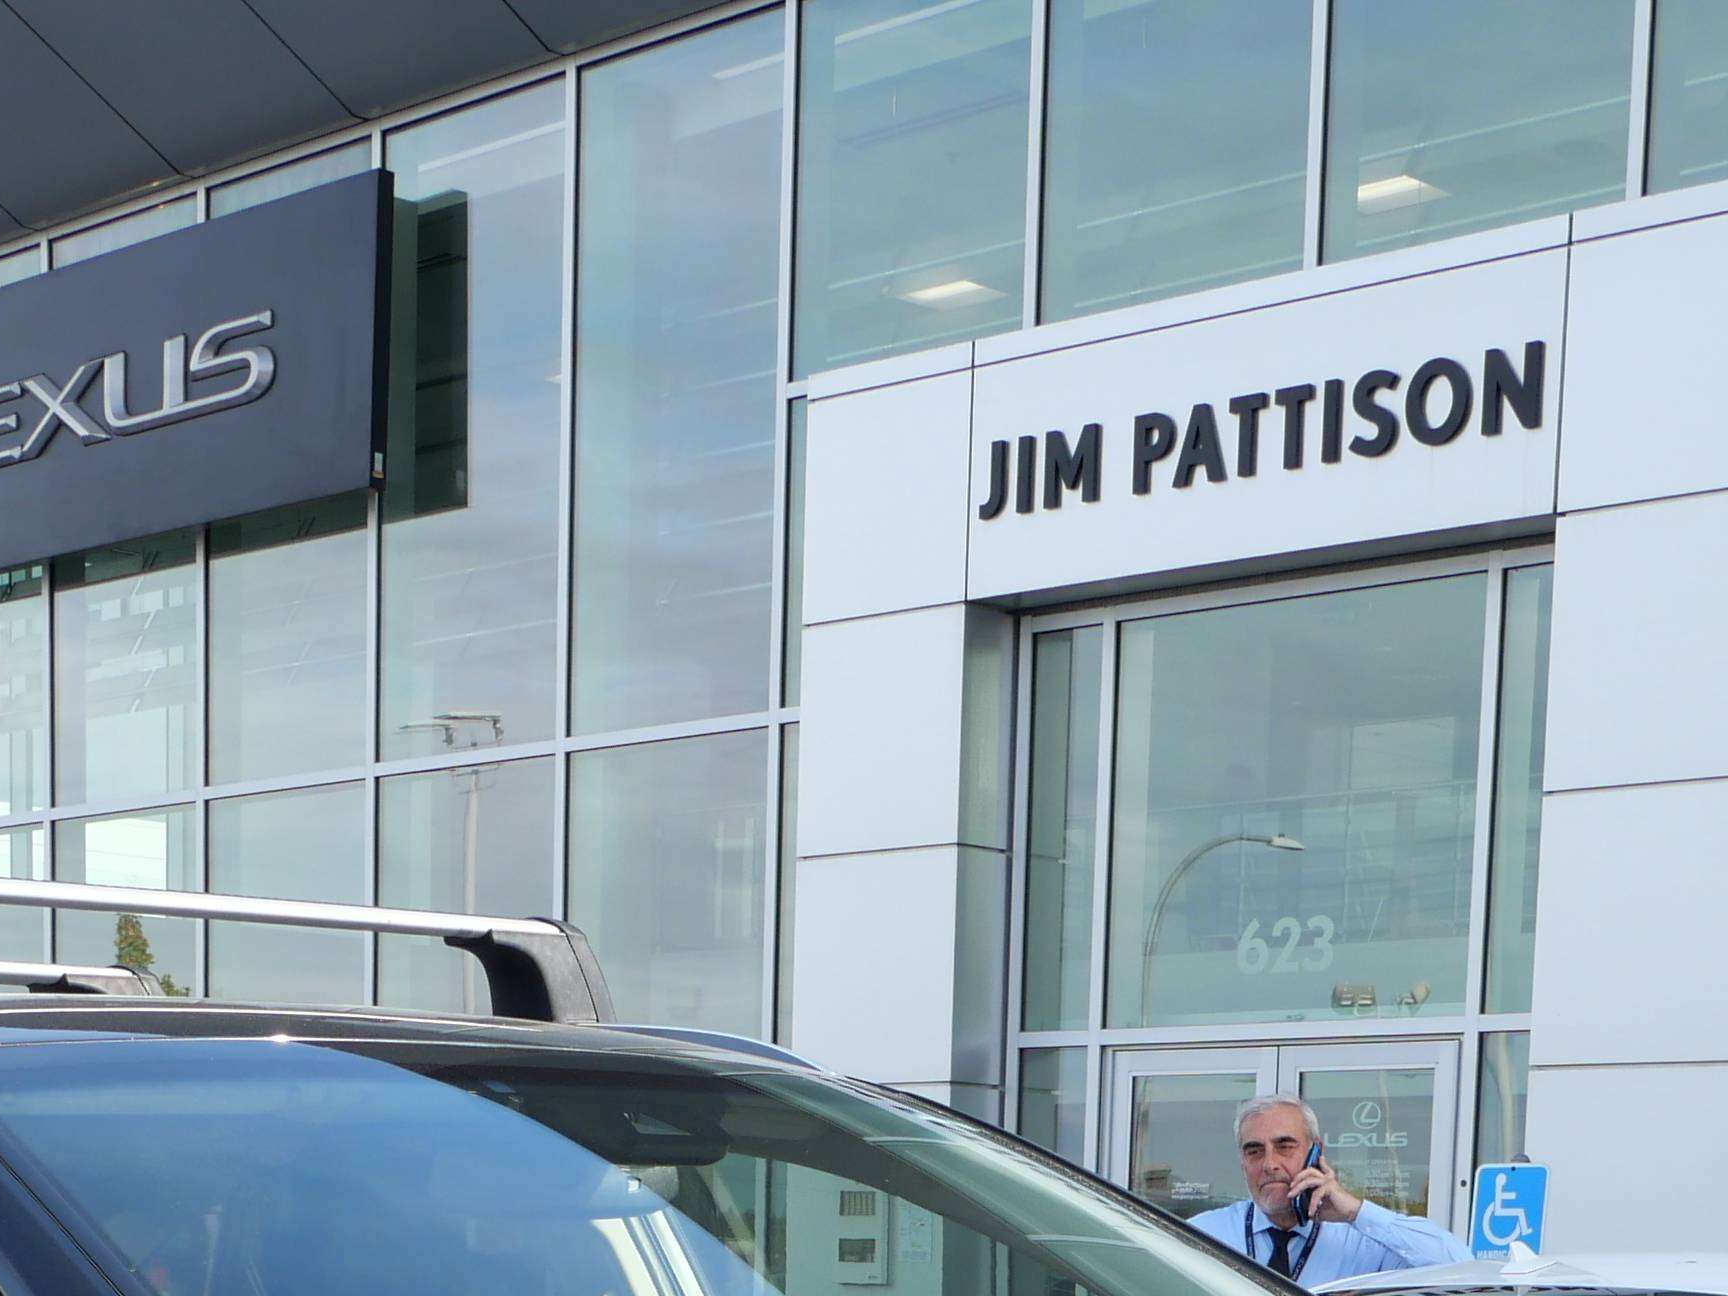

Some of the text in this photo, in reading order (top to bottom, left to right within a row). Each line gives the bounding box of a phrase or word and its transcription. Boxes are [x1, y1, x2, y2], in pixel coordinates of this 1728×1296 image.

[978, 340, 1548, 520] JIM PATTISON
[1237, 914, 1334, 975] 623
[1324, 1131, 1408, 1148] LEXUS
